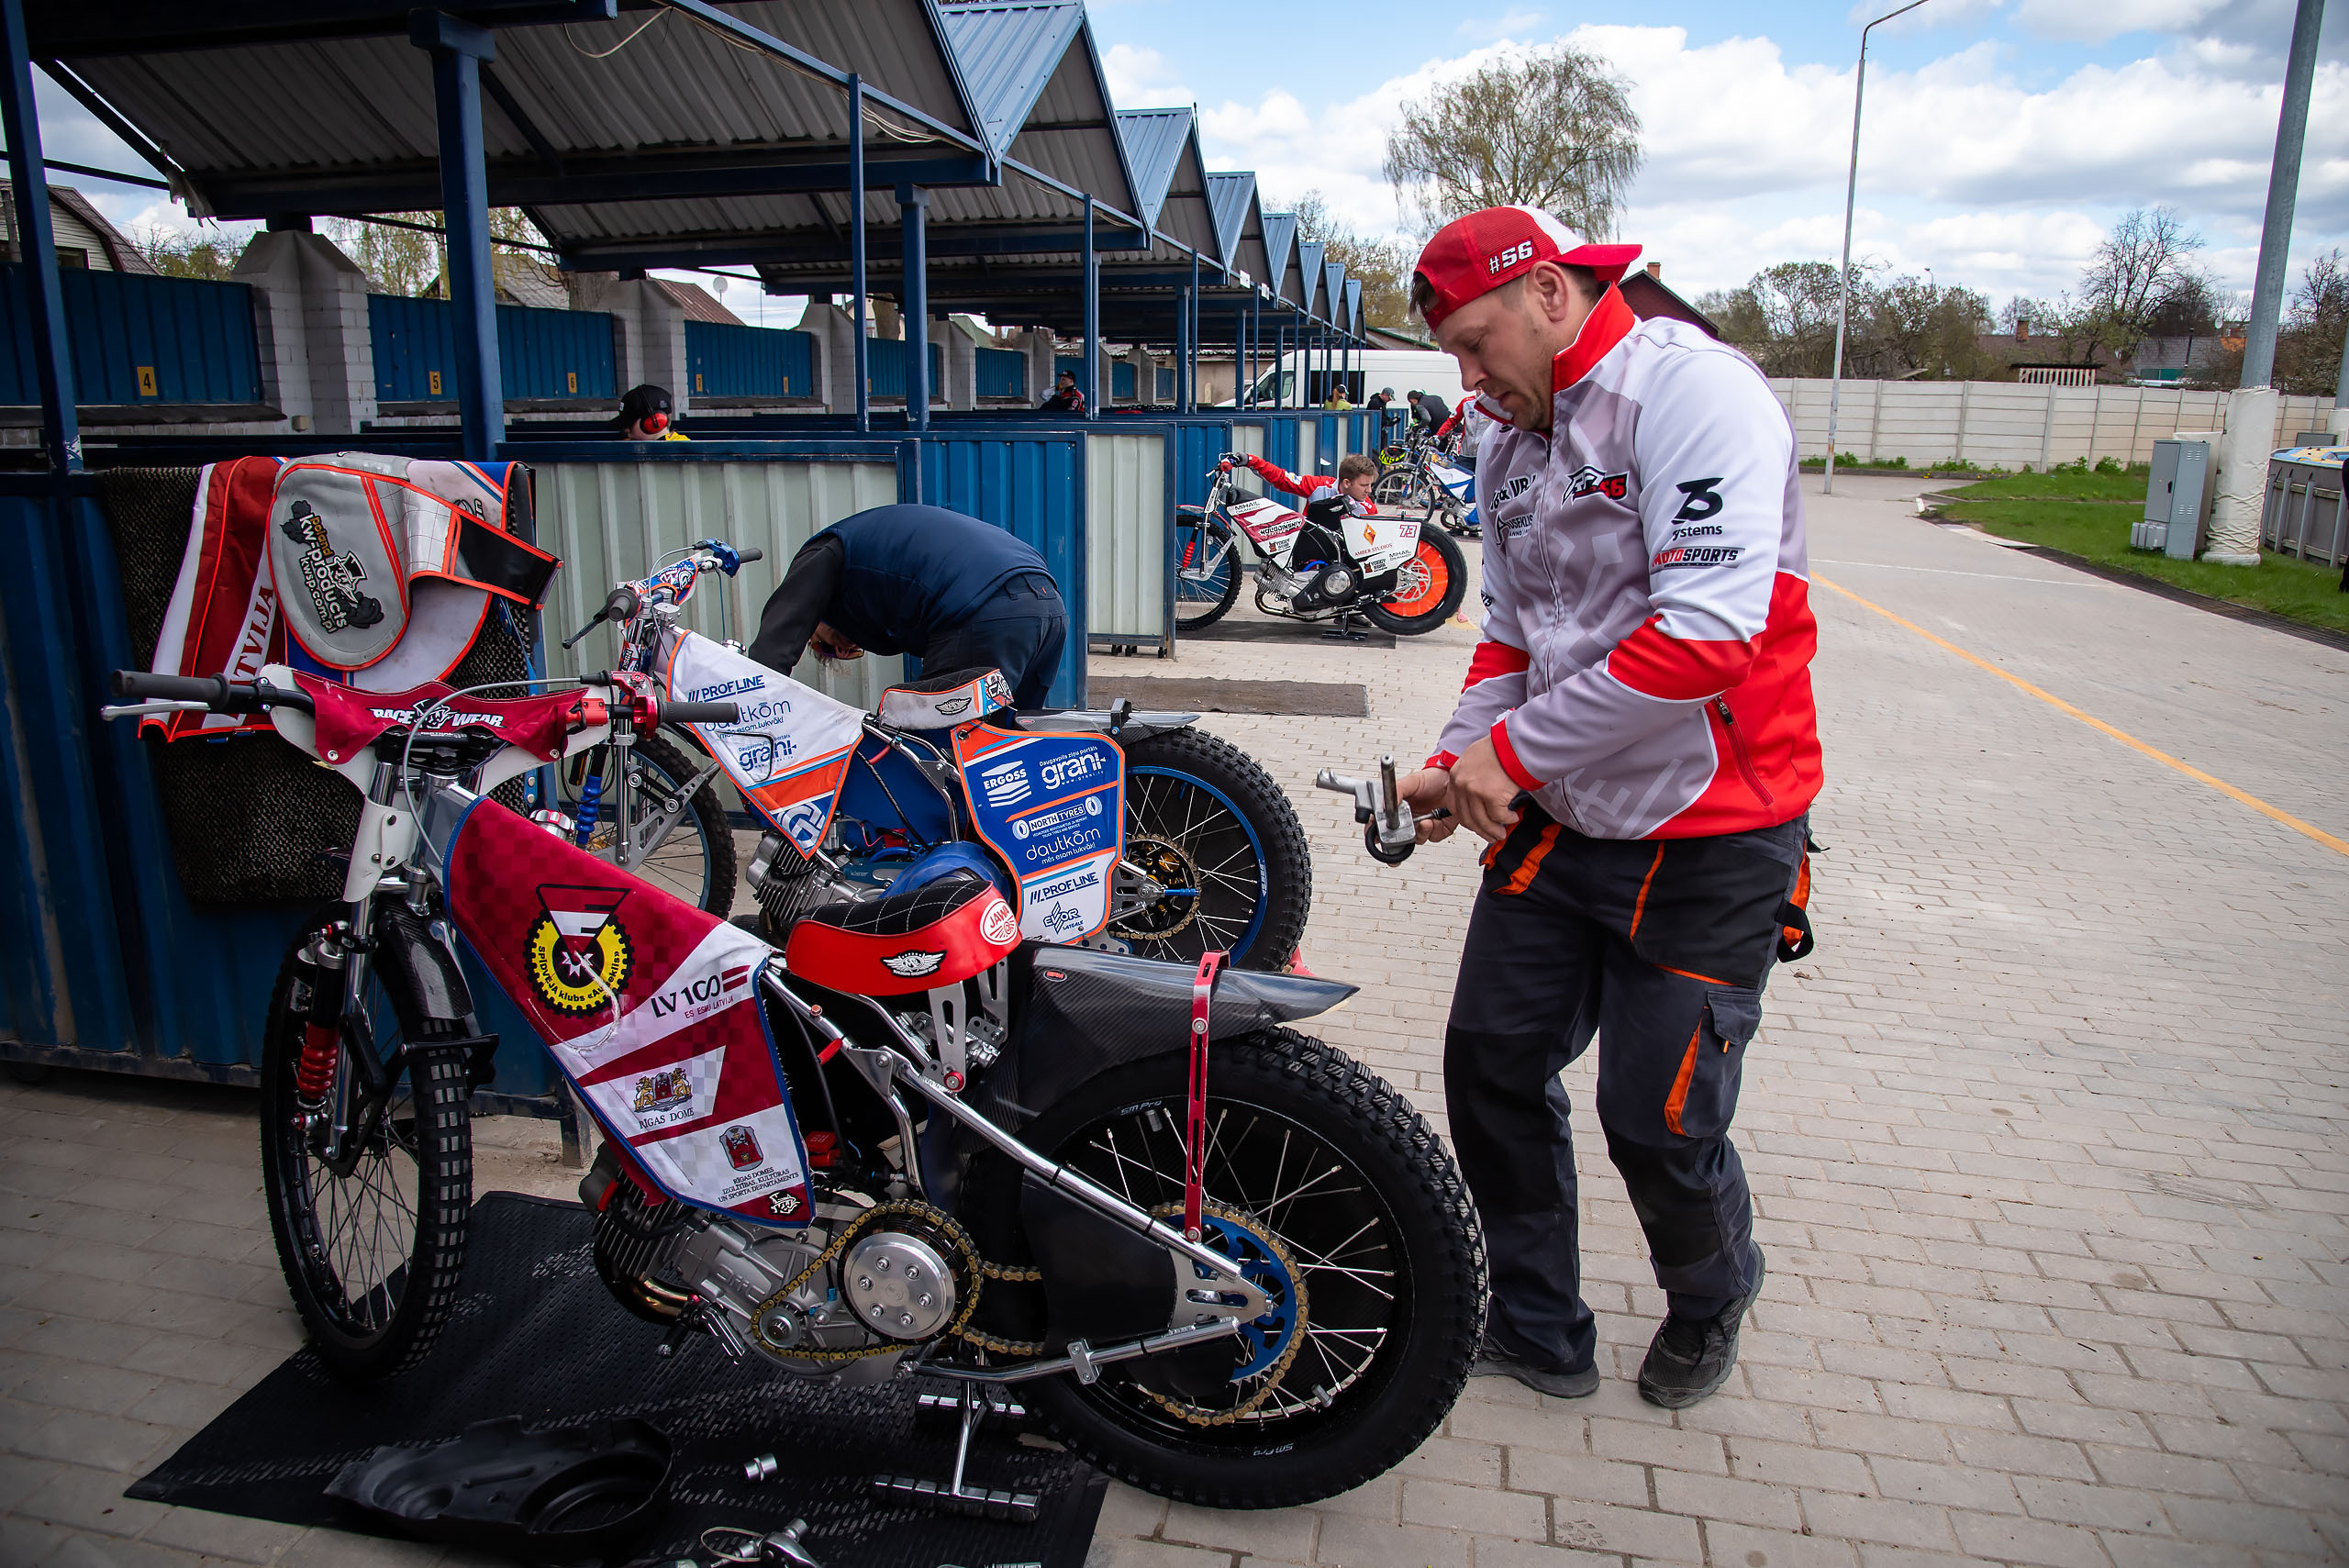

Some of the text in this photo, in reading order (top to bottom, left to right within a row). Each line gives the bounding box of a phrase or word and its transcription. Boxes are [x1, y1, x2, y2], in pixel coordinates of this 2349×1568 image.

[1489, 240, 1533, 274] #56
[143, 373, 151, 390] 4
[432, 375, 440, 390] 5
[310, 516, 334, 556] poland
[1399, 524, 1418, 539] 73
[299, 514, 348, 628] kw-products
[300, 557, 338, 634] kwsp.com.pl
[369, 708, 507, 728] RACE WEAR
[983, 768, 1027, 790] ERGOSS
[1030, 815, 1057, 830] NORTH
[1059, 806, 1085, 820] TYRES
[1056, 851, 1073, 861] esam
[989, 905, 1010, 929] JAWA
[1063, 920, 1084, 930] LATGALE
[559, 990, 585, 1002] klubs
[651, 974, 721, 1018] LV 100
[685, 995, 734, 1018] ES ESMU LATVIJA
[640, 1107, 695, 1129] RĪGAS DOME
[732, 1166, 775, 1185] RĪGAS DOMES
[718, 1172, 799, 1203] UN SPORTA DEPARTAMENTS
